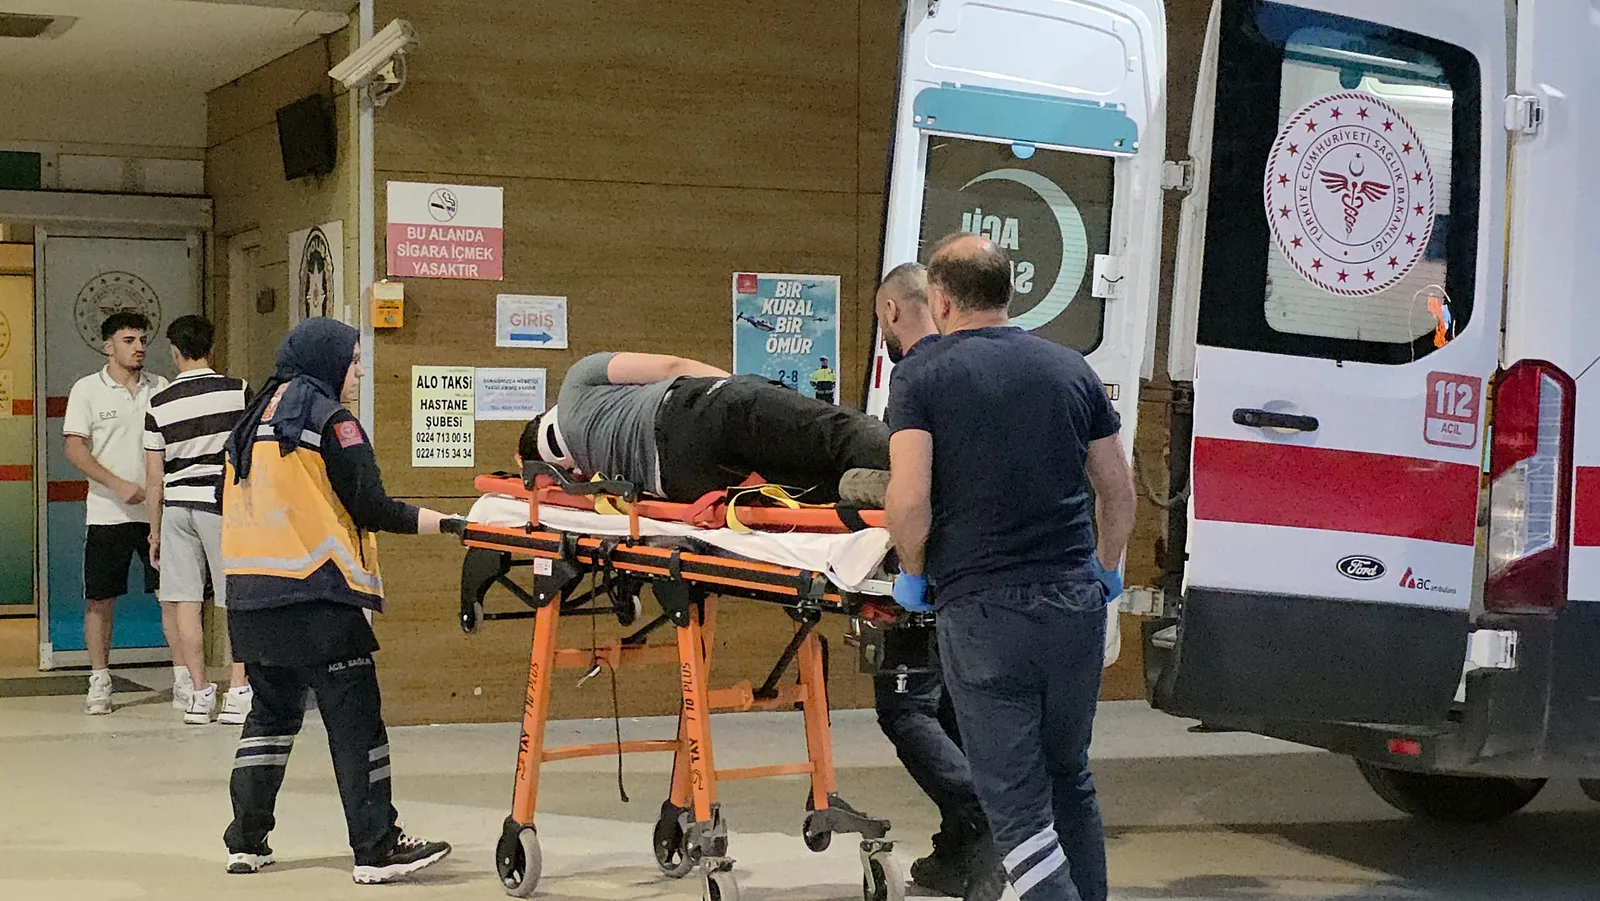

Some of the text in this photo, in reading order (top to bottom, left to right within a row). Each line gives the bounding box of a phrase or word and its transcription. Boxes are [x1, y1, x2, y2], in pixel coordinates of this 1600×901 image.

[1299, 130, 1405, 253] TÜRKİYE CUMHURİYETİ SAĞLIK BAKANLIĞI
[407, 226, 485, 242] BU ALANDA
[397, 241, 494, 262] SİGARA İÇMEK
[412, 262, 479, 277] YASAKTIR
[761, 298, 814, 316] KURAL
[510, 310, 554, 331] GİRİŞ
[765, 334, 813, 355] ÖMÜR
[416, 375, 438, 389] ALO
[420, 399, 468, 410] HASTANE
[1435, 380, 1473, 417] 112
[416, 432, 472, 443] 0224 713 00 51
[416, 448, 472, 458] 0224 715 34 34
[1346, 559, 1379, 576] Ford
[682, 662, 692, 692] PLUS
[689, 738, 700, 764] TAY
